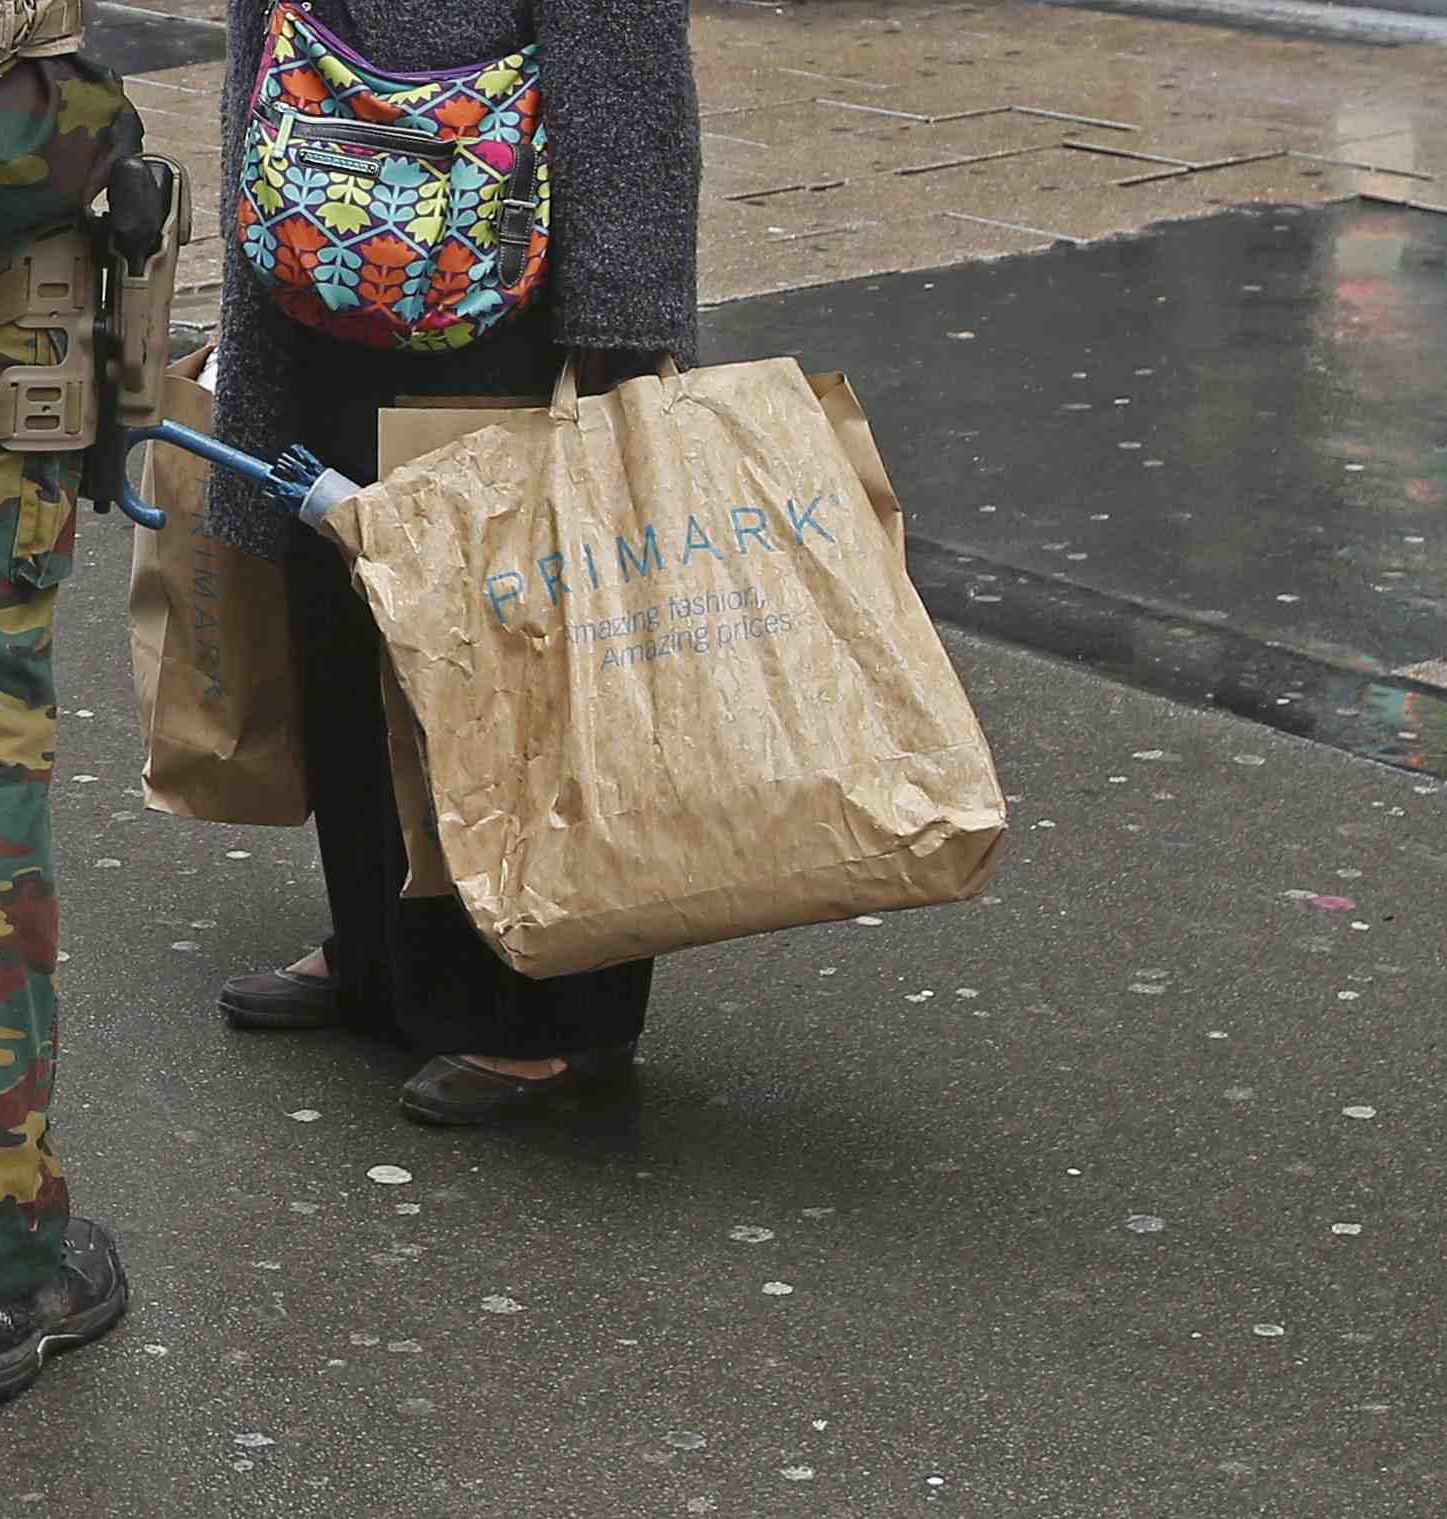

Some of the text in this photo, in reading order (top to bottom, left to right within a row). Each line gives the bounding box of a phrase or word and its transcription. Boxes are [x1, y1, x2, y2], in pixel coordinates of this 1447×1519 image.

[486, 495, 838, 624] PRIMARK
[669, 584, 768, 620] fashion,
[601, 612, 794, 671] Amazing prices
